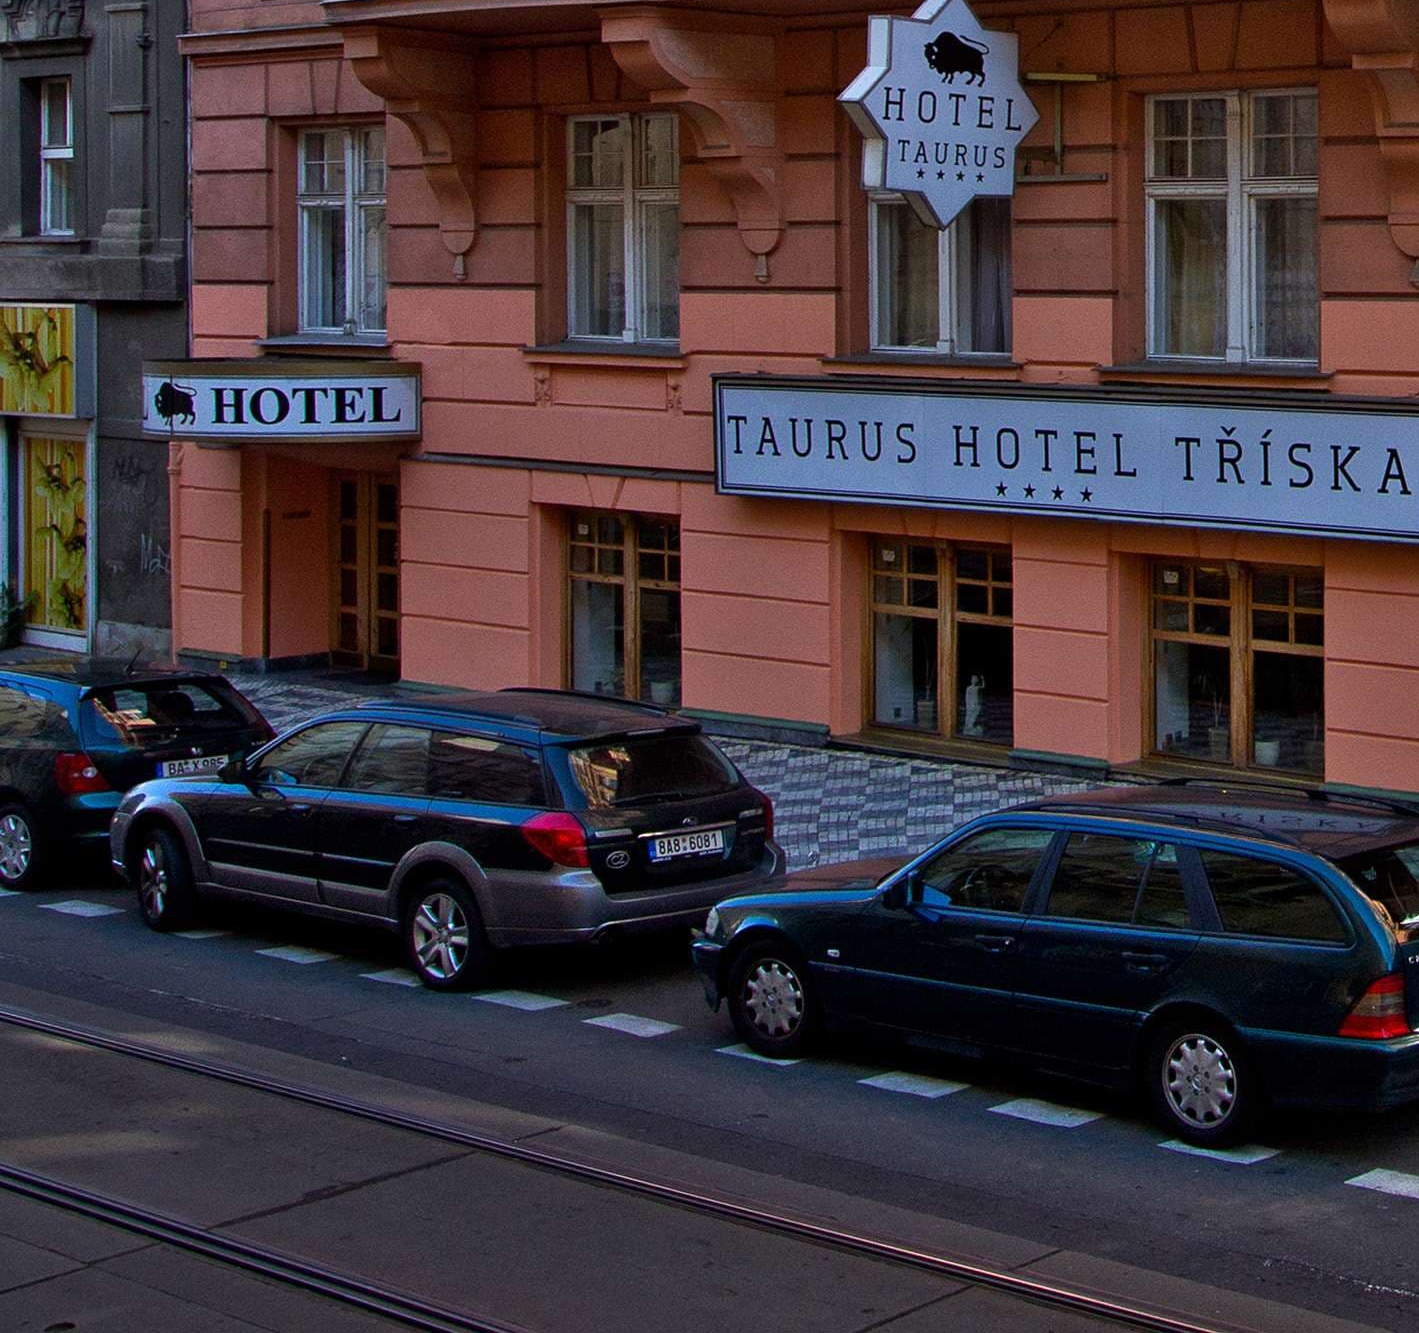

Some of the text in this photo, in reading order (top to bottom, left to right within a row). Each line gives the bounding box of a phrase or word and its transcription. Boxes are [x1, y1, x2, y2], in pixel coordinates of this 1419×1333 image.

[882, 86, 1022, 132] HOTEL
[898, 139, 1006, 169] TAURUS
[210, 386, 402, 426] HOTEL
[727, 415, 1413, 496] TAURUS HOTEL TŘÍSKA
[612, 853, 625, 865] CZ
[658, 838, 681, 854] 8A8
[689, 833, 718, 850] 6081
